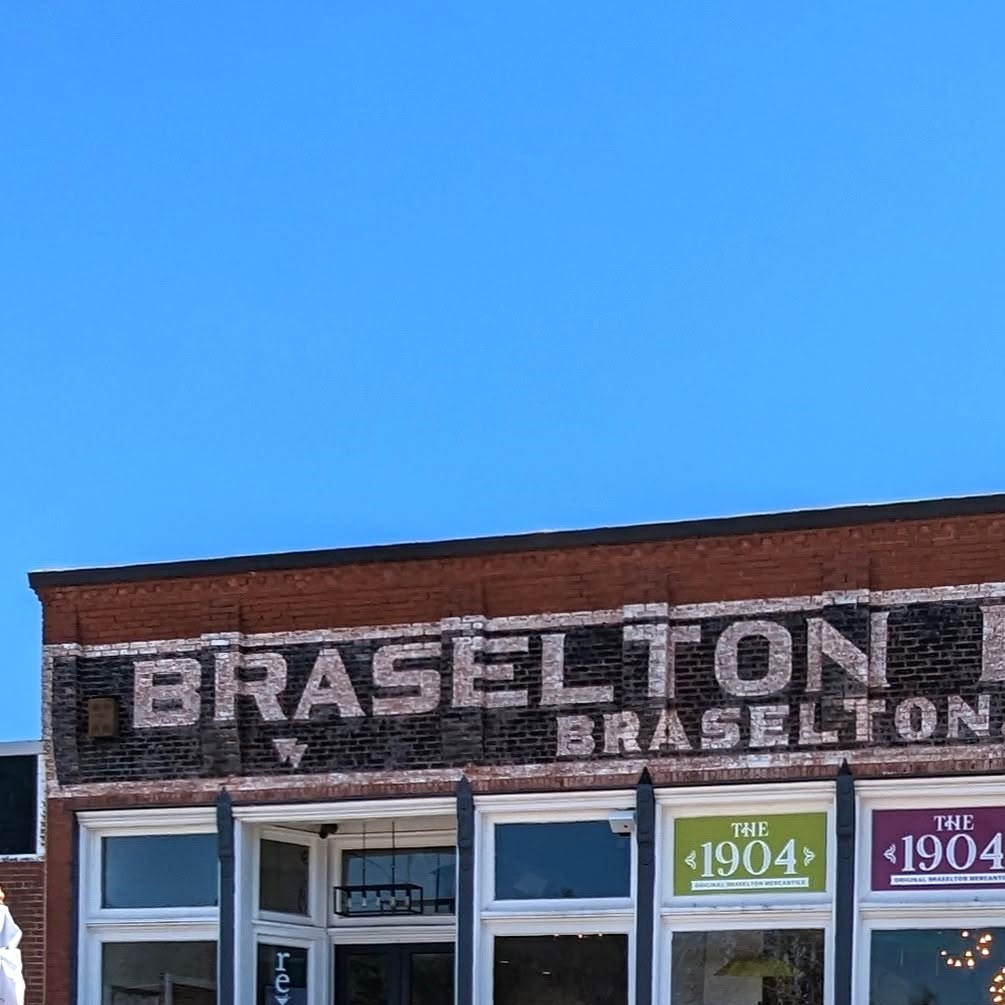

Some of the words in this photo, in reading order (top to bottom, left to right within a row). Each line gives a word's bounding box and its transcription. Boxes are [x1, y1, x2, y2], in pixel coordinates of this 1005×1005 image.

[131, 612, 890, 729] BRASELTON
[731, 821, 770, 838] THE
[933, 814, 975, 832] THE
[701, 838, 798, 878] 1904
[901, 832, 1005, 872] 1904
